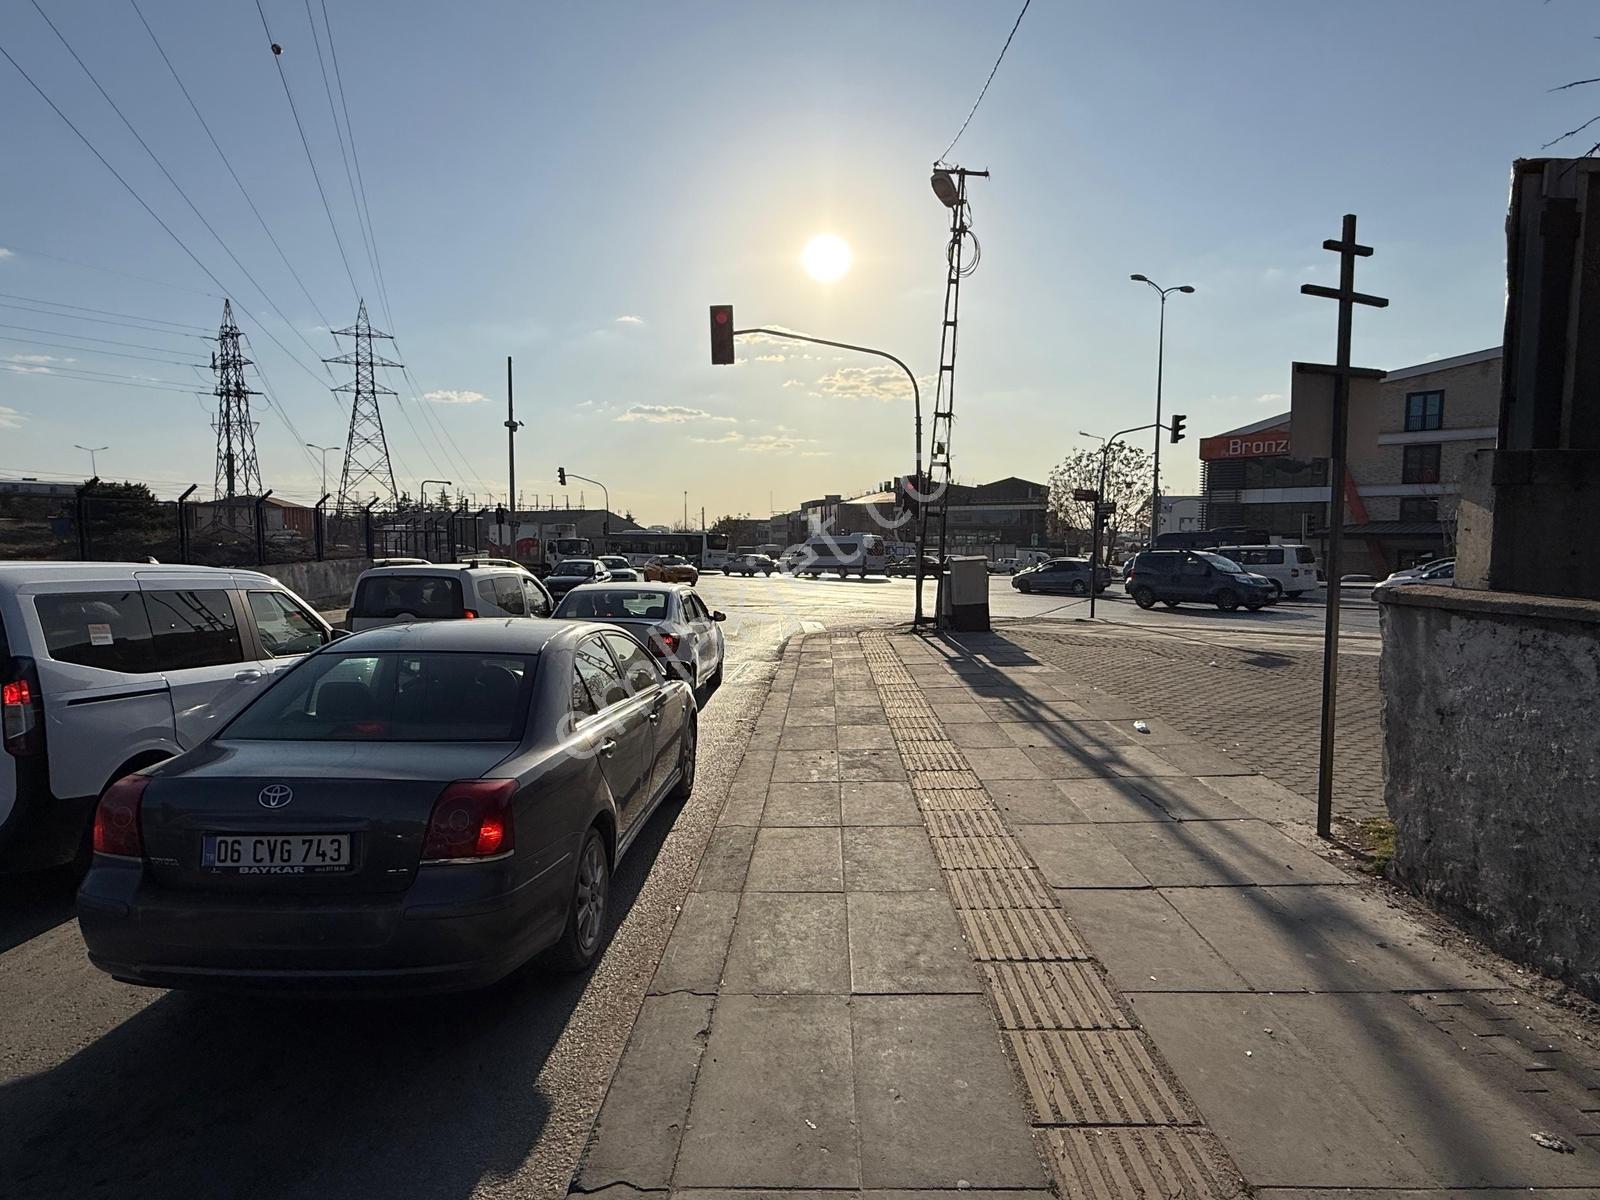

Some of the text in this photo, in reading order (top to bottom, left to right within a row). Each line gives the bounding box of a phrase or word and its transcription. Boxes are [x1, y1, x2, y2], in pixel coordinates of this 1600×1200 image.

[1229, 438, 1290, 455] Bronz
[217, 838, 342, 863] 06 CVG 743
[239, 866, 305, 874] BAYKAR
